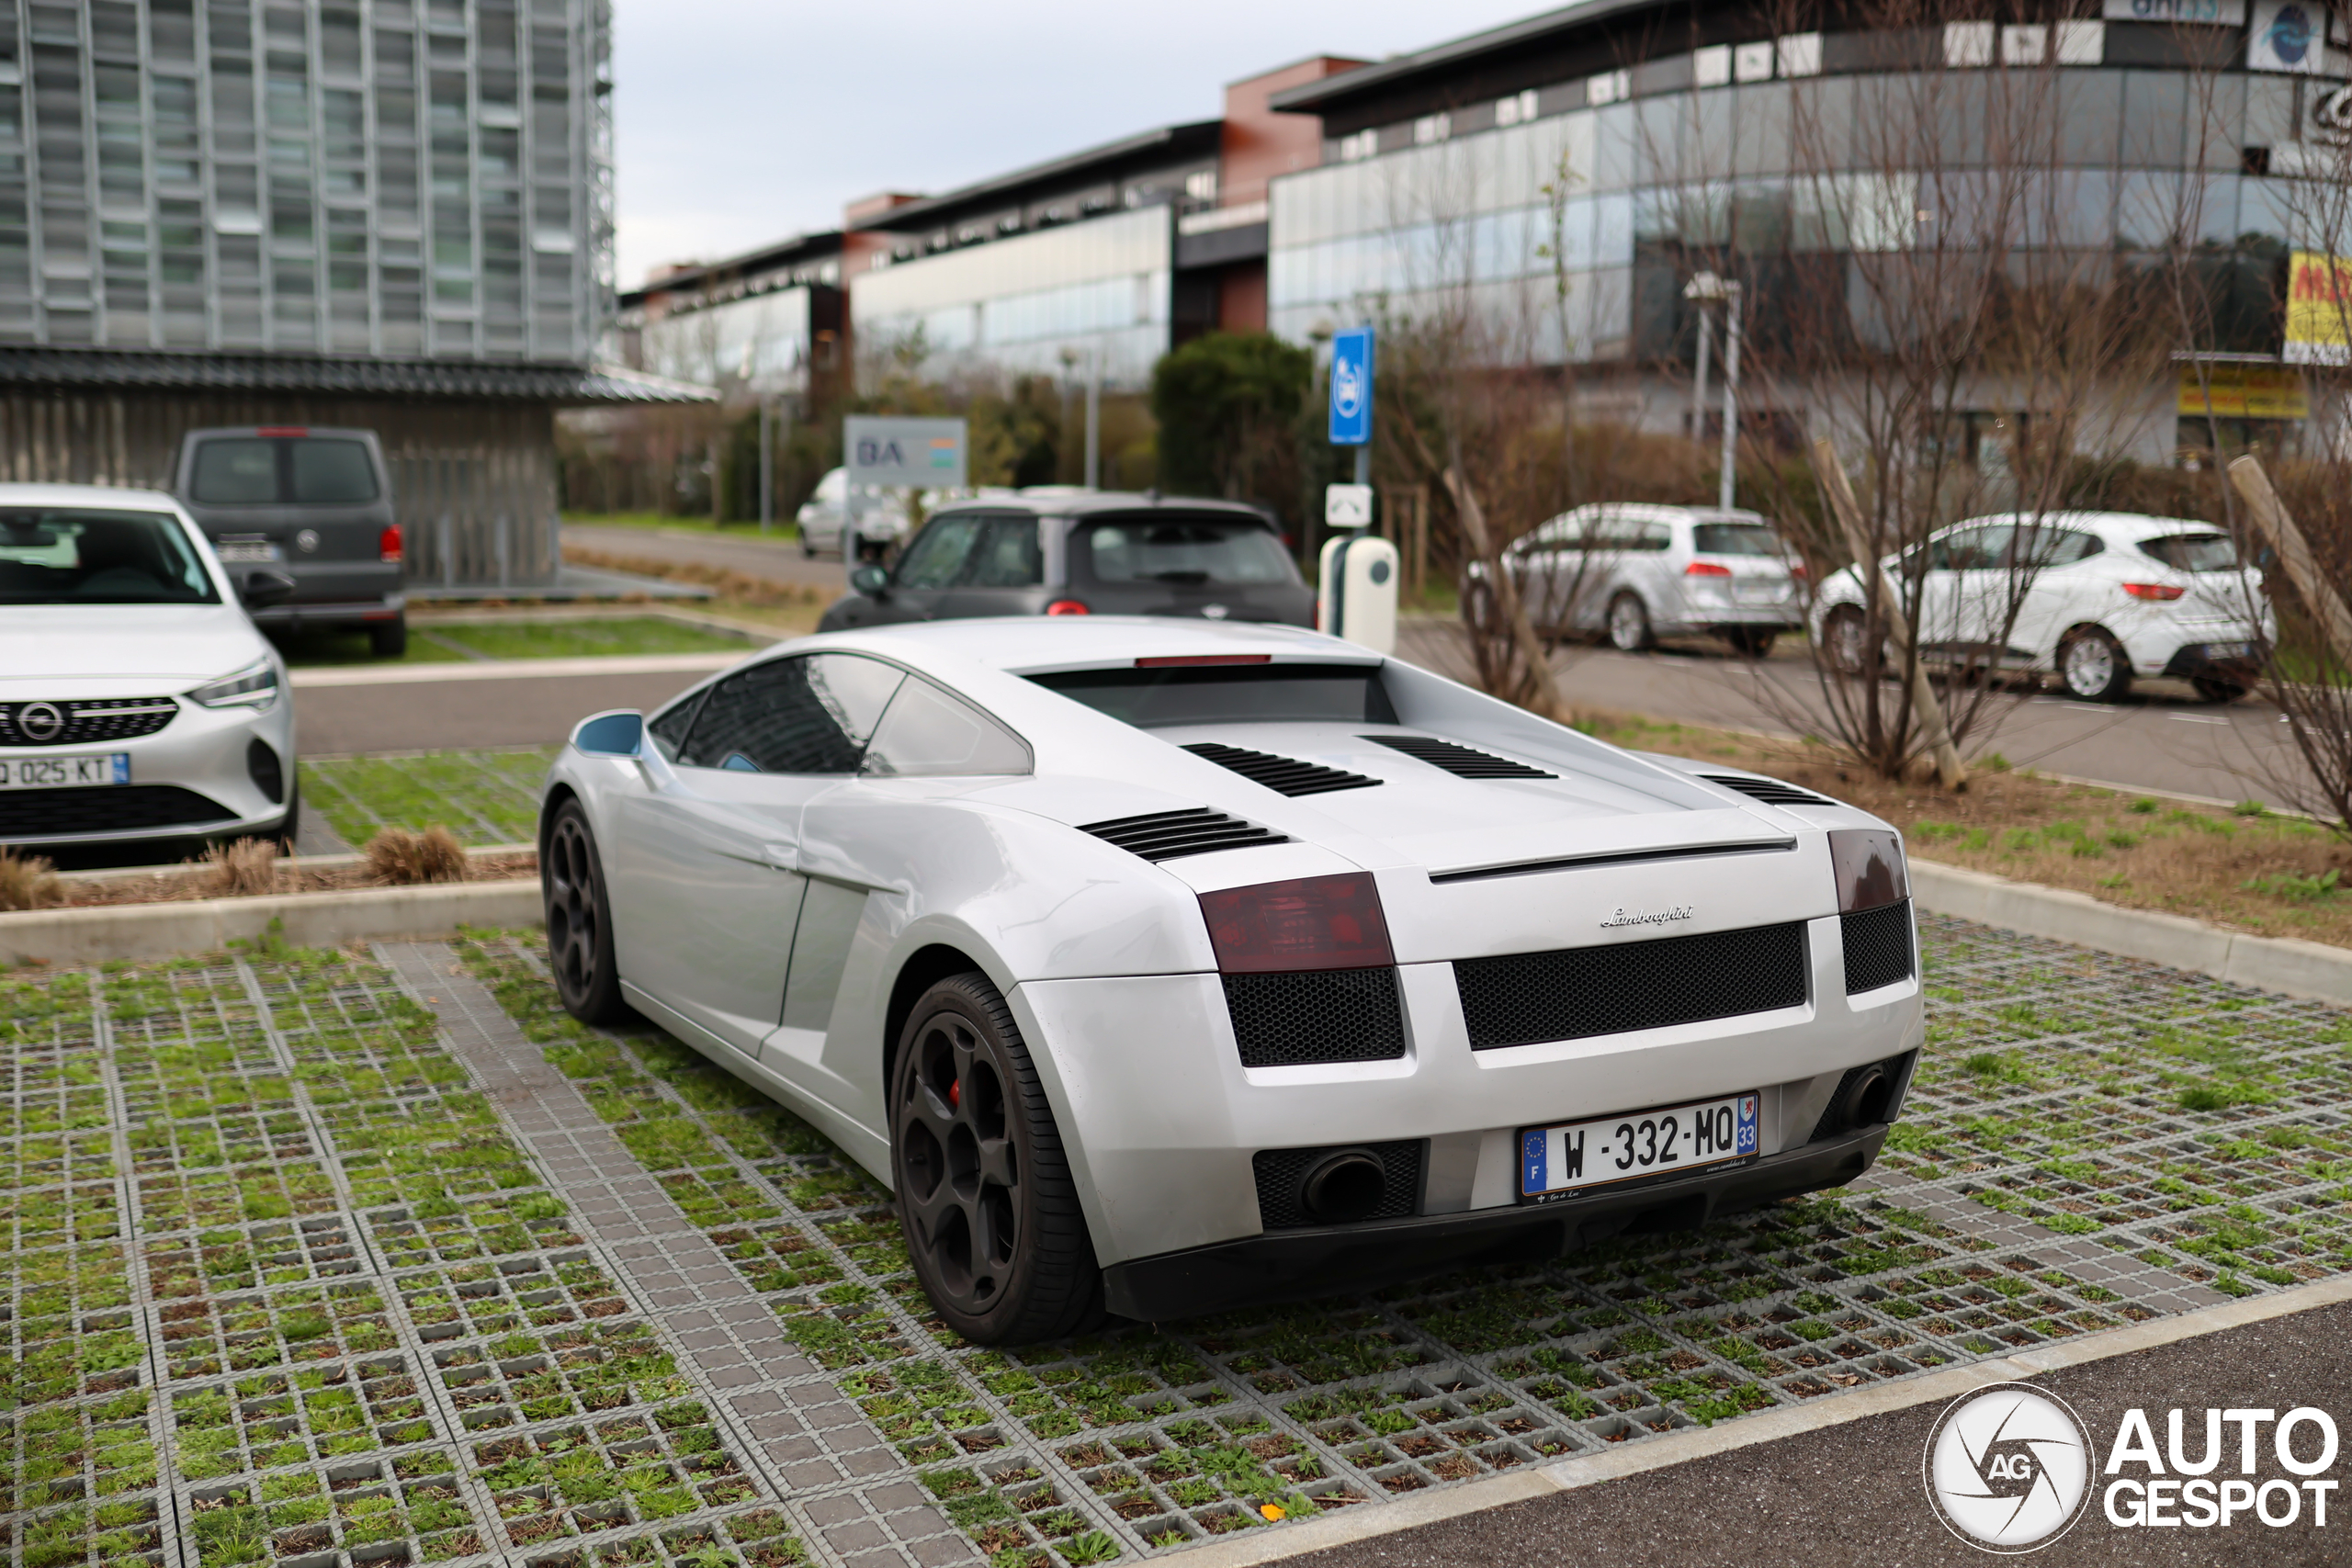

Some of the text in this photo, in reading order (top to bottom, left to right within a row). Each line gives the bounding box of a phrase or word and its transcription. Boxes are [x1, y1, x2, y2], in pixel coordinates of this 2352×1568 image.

[1600, 905, 1694, 927] Lamborghini
[1738, 1124, 1755, 1147] 33
[1532, 1165, 1539, 1179] F
